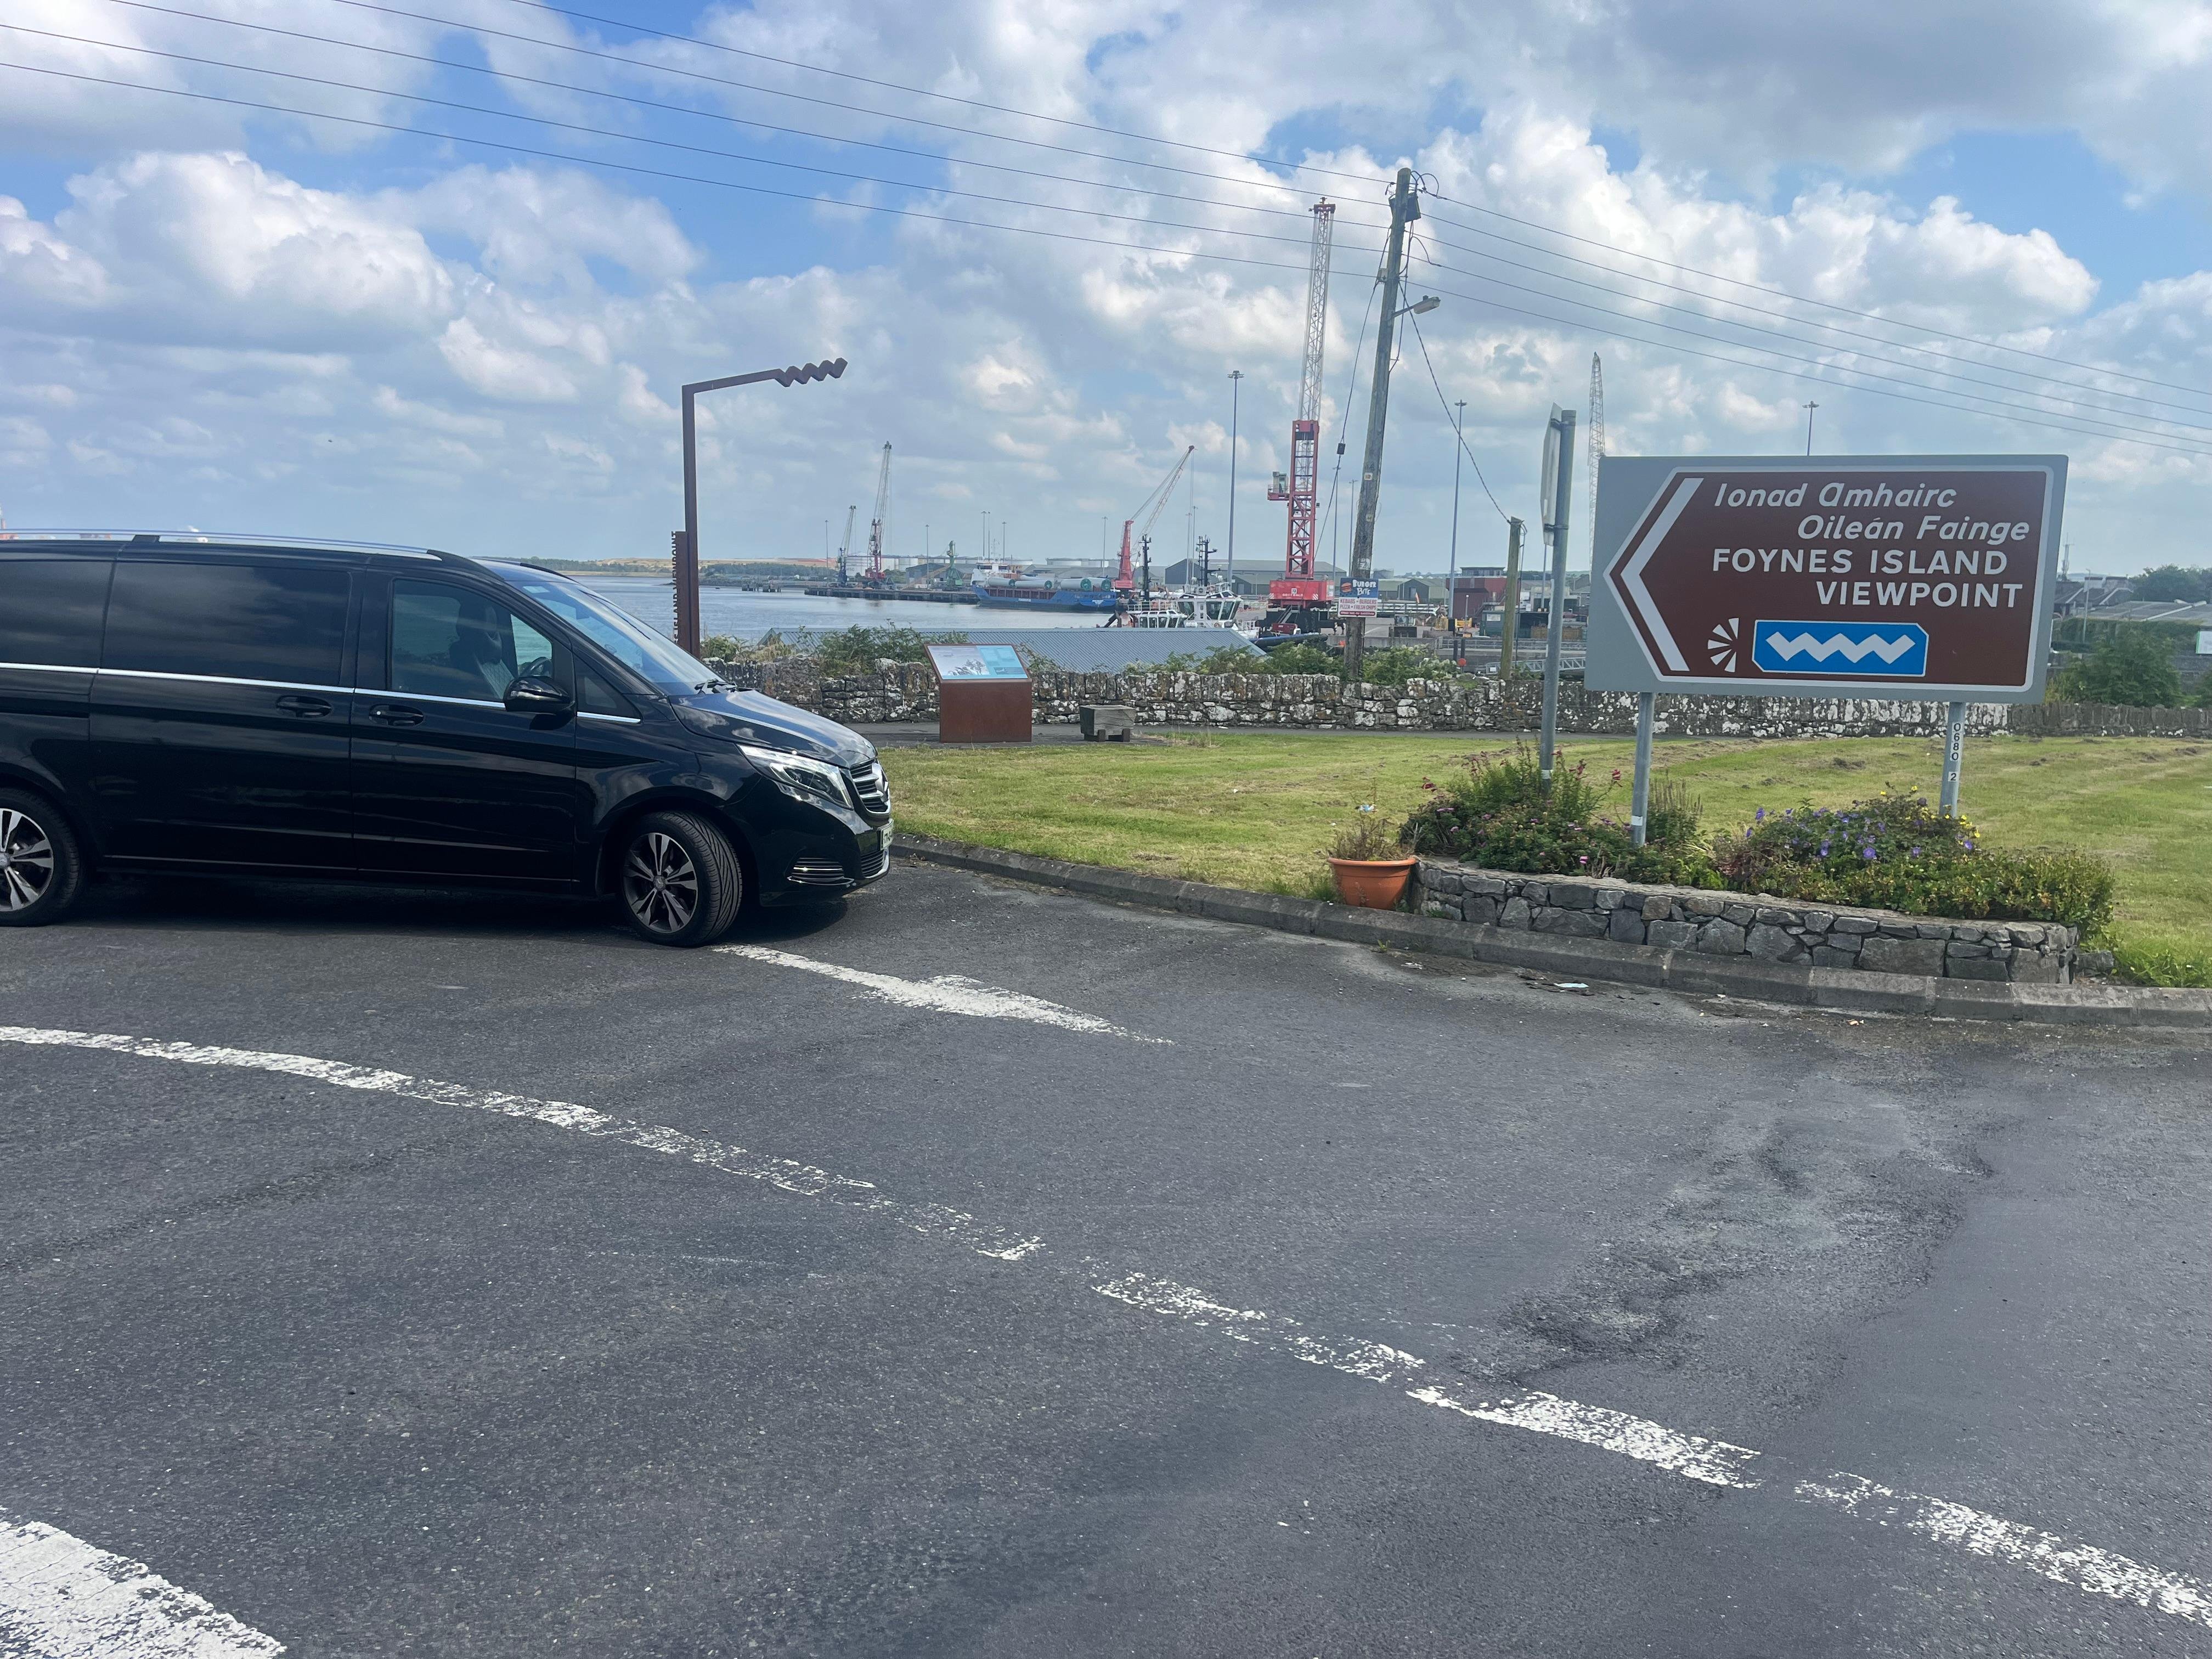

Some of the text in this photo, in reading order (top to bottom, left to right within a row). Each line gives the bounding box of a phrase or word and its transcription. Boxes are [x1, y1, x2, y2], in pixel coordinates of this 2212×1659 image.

[1714, 483, 1808, 507] Ionad
[1797, 515, 2030, 546] Oileán Fainge
[1712, 548, 2008, 575] FOYNES ISLAND
[1816, 581, 2023, 608] VIEWPOINT
[1951, 723, 1961, 761] 0680
[1950, 772, 1957, 781] 2
